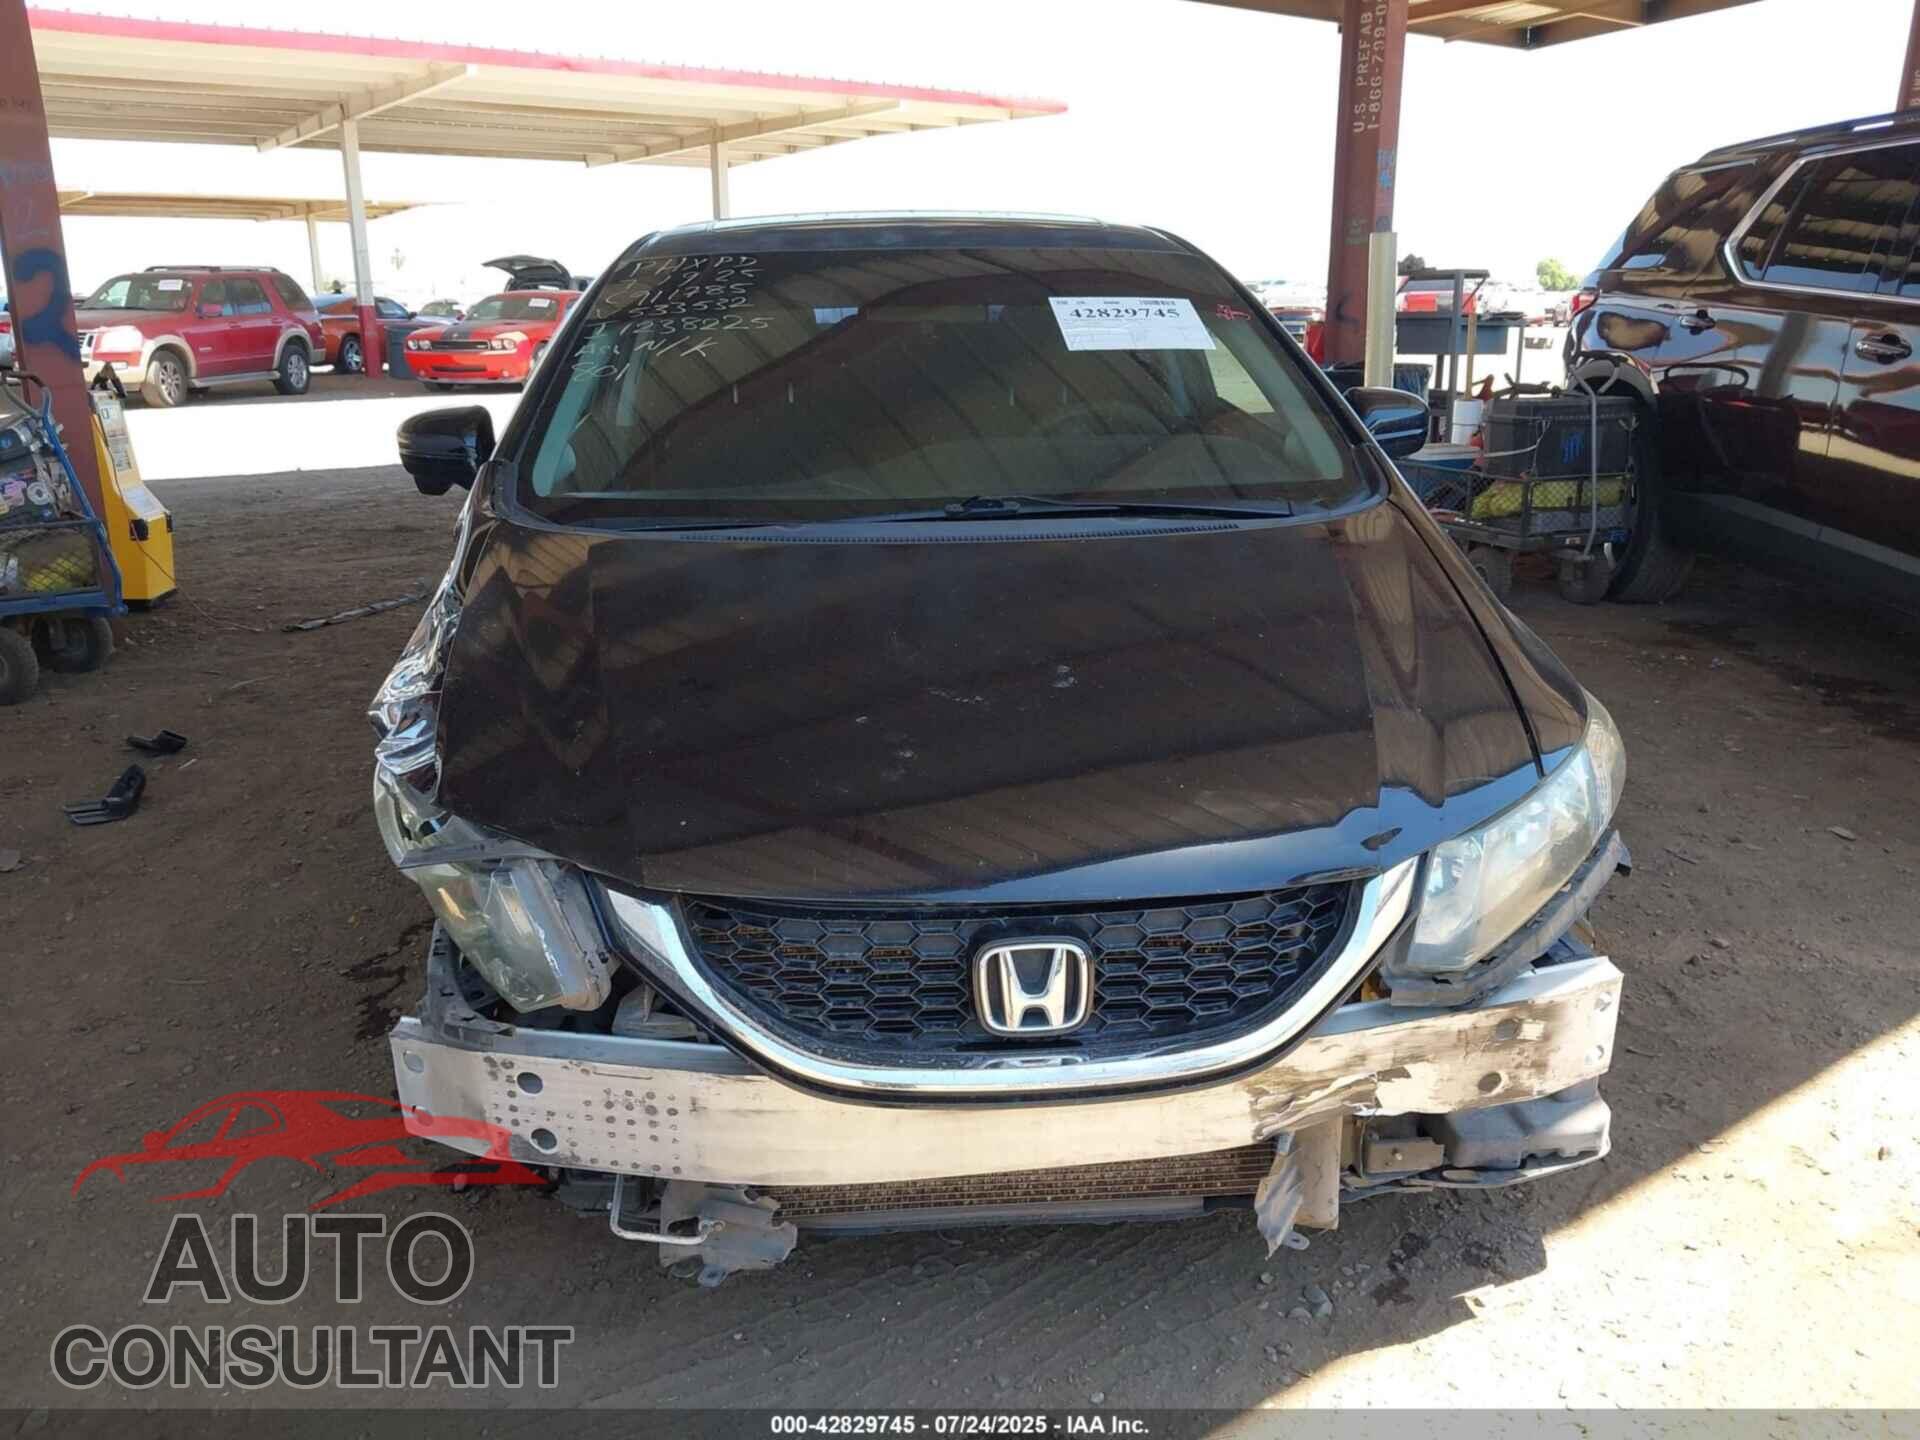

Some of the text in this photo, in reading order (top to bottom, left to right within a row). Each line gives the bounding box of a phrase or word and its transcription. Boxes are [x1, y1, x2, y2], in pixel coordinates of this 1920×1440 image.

[1356, 11, 1373, 86] PREFAB
[1367, 0, 1388, 130] 1-866-709-0
[1070, 307, 1181, 319] 42829745
